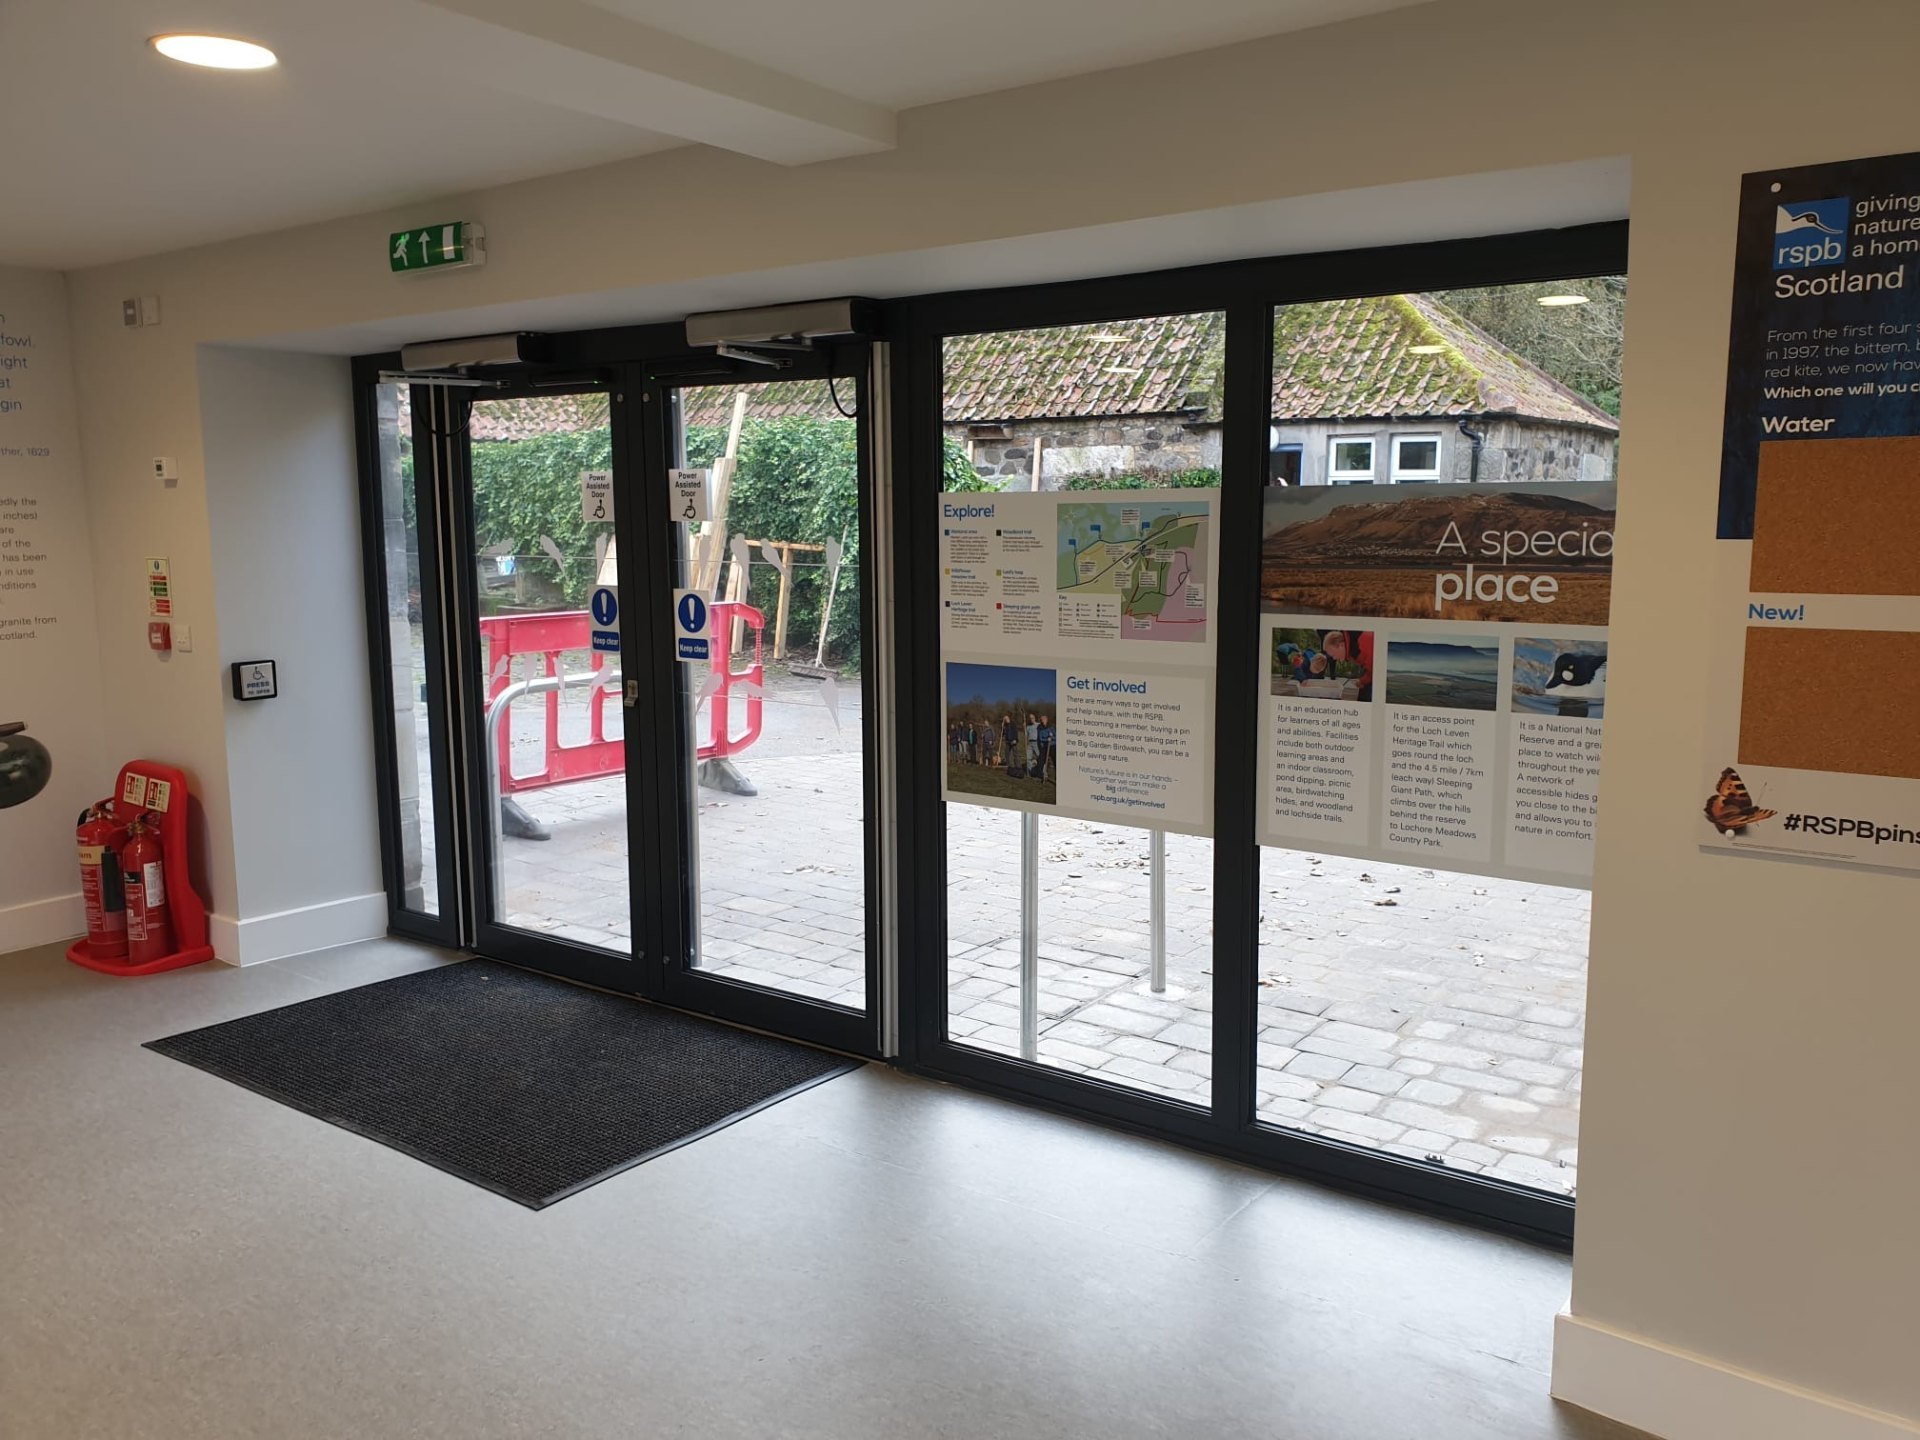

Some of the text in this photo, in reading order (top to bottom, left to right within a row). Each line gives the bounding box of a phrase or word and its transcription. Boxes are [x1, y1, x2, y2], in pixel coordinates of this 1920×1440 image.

[1856, 194, 1920, 217] giving
[1855, 218, 1920, 235] nature
[1778, 237, 1841, 267] rspb
[1852, 240, 1920, 257] a hom
[1775, 265, 1904, 298] Scotland
[1768, 323, 1911, 342] From the first four
[1766, 349, 1778, 360] in
[1783, 346, 1819, 359] 1997,
[1825, 345, 1849, 357] the
[1765, 362, 1888, 378] red kite, we now
[1764, 383, 1906, 399] Which one will you
[1762, 417, 1835, 433] Water
[944, 505, 994, 521] Explore!
[1436, 521, 1467, 554] A
[1435, 564, 1558, 611] place
[1748, 603, 1804, 620] New!
[594, 637, 605, 645] Keep
[680, 644, 692, 653] Keep
[1067, 676, 1146, 693] Get involved
[1305, 706, 1341, 715] education
[1290, 716, 1319, 725] learners
[1423, 715, 1451, 723] access
[1326, 731, 1358, 740] Facilities
[1393, 724, 1403, 732] for
[1422, 727, 1441, 735] Loch
[1445, 729, 1469, 737] Leven
[1546, 724, 1583, 734] National
[1277, 739, 1354, 752] include both outdoor
[1393, 737, 1472, 750] Heritage Trail which
[1520, 734, 1554, 745] Reserve
[1277, 750, 1306, 761] learning
[1414, 752, 1437, 760] round
[1456, 754, 1473, 763] loch
[1556, 753, 1583, 761] watch
[1586, 754, 1600, 762] wil
[1313, 766, 1354, 777] classroom,
[1409, 763, 1422, 771] the
[1440, 766, 1457, 774] mile
[1466, 768, 1483, 776] 7km
[1518, 761, 1584, 773] throughout the
[1437, 778, 1472, 790] Sleeping
[1527, 776, 1562, 784] network
[1391, 786, 1462, 800] Giant Path, which
[1517, 786, 1589, 800] accessible hides
[1391, 798, 1416, 807] climbs
[1455, 805, 1471, 813] hills
[1534, 801, 1557, 810] close
[1572, 805, 1586, 813] the
[1390, 810, 1466, 825] behind the reserve
[1515, 812, 1531, 820] and
[1534, 814, 1561, 823] allows
[1565, 817, 1580, 826] you
[1401, 823, 1432, 833] Lochore
[1436, 827, 1476, 838] Meadows
[1515, 824, 1542, 834] nature
[1545, 826, 1553, 835] in
[1389, 834, 1421, 844] Country
